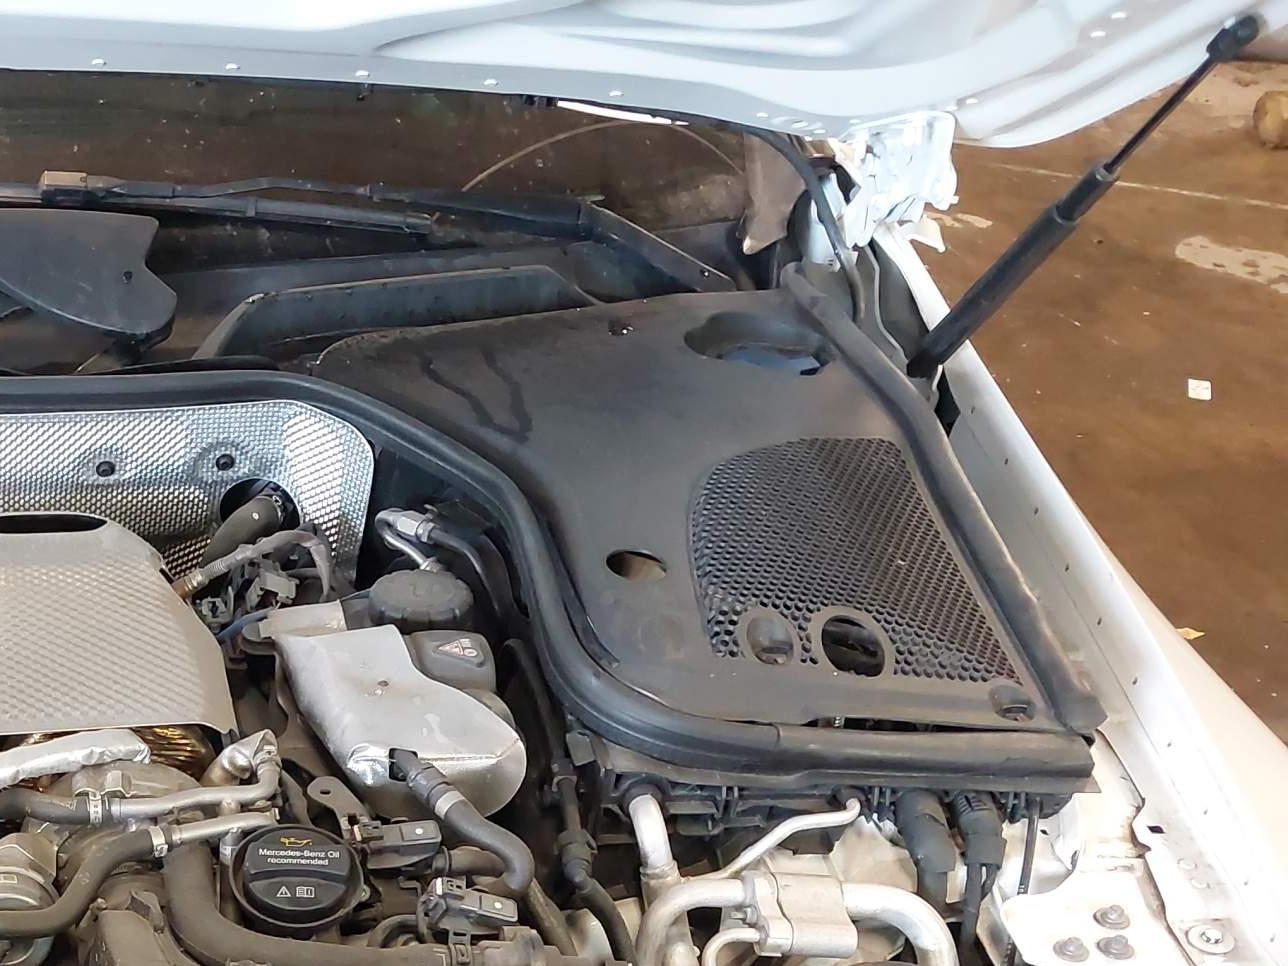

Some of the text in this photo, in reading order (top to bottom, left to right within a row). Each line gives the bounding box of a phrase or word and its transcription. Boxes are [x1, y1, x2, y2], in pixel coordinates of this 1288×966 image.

[258, 848, 340, 859] Mercedes-Benz Oil
[267, 857, 329, 865] recommended
